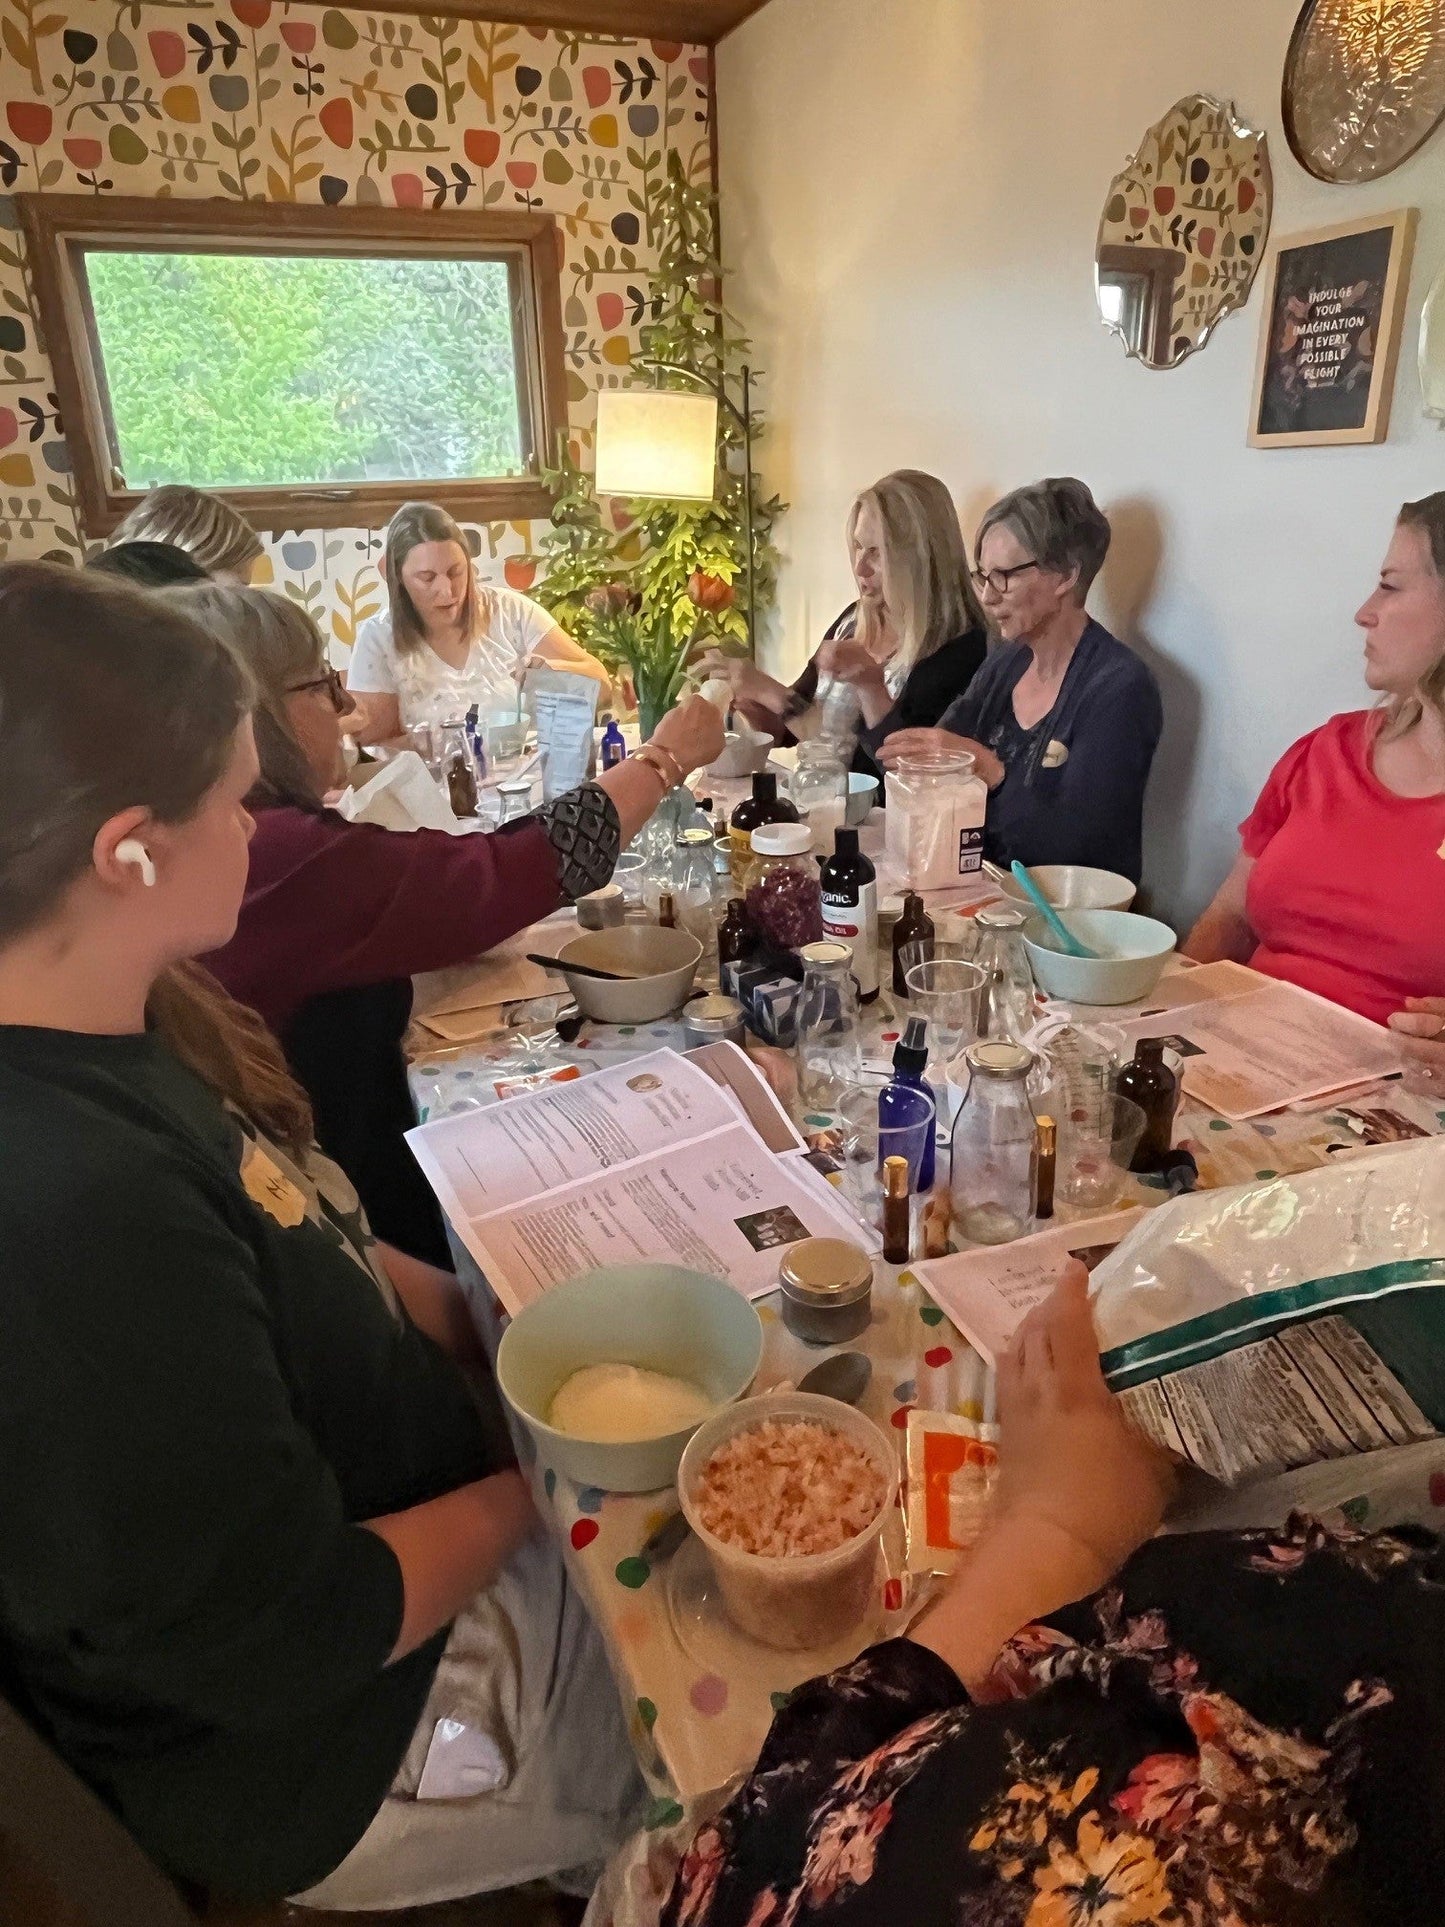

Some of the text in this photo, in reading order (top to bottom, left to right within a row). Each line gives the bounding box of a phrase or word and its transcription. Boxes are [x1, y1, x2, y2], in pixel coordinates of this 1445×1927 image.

[1309, 286, 1353, 303] INDULGE
[1316, 303, 1342, 317] YOUR
[1293, 316, 1364, 336] IMAGINATION
[1303, 333, 1349, 349] IN EVERY
[1301, 348, 1348, 364] POSSIBLE
[1304, 366, 1341, 380] FLIGHT
